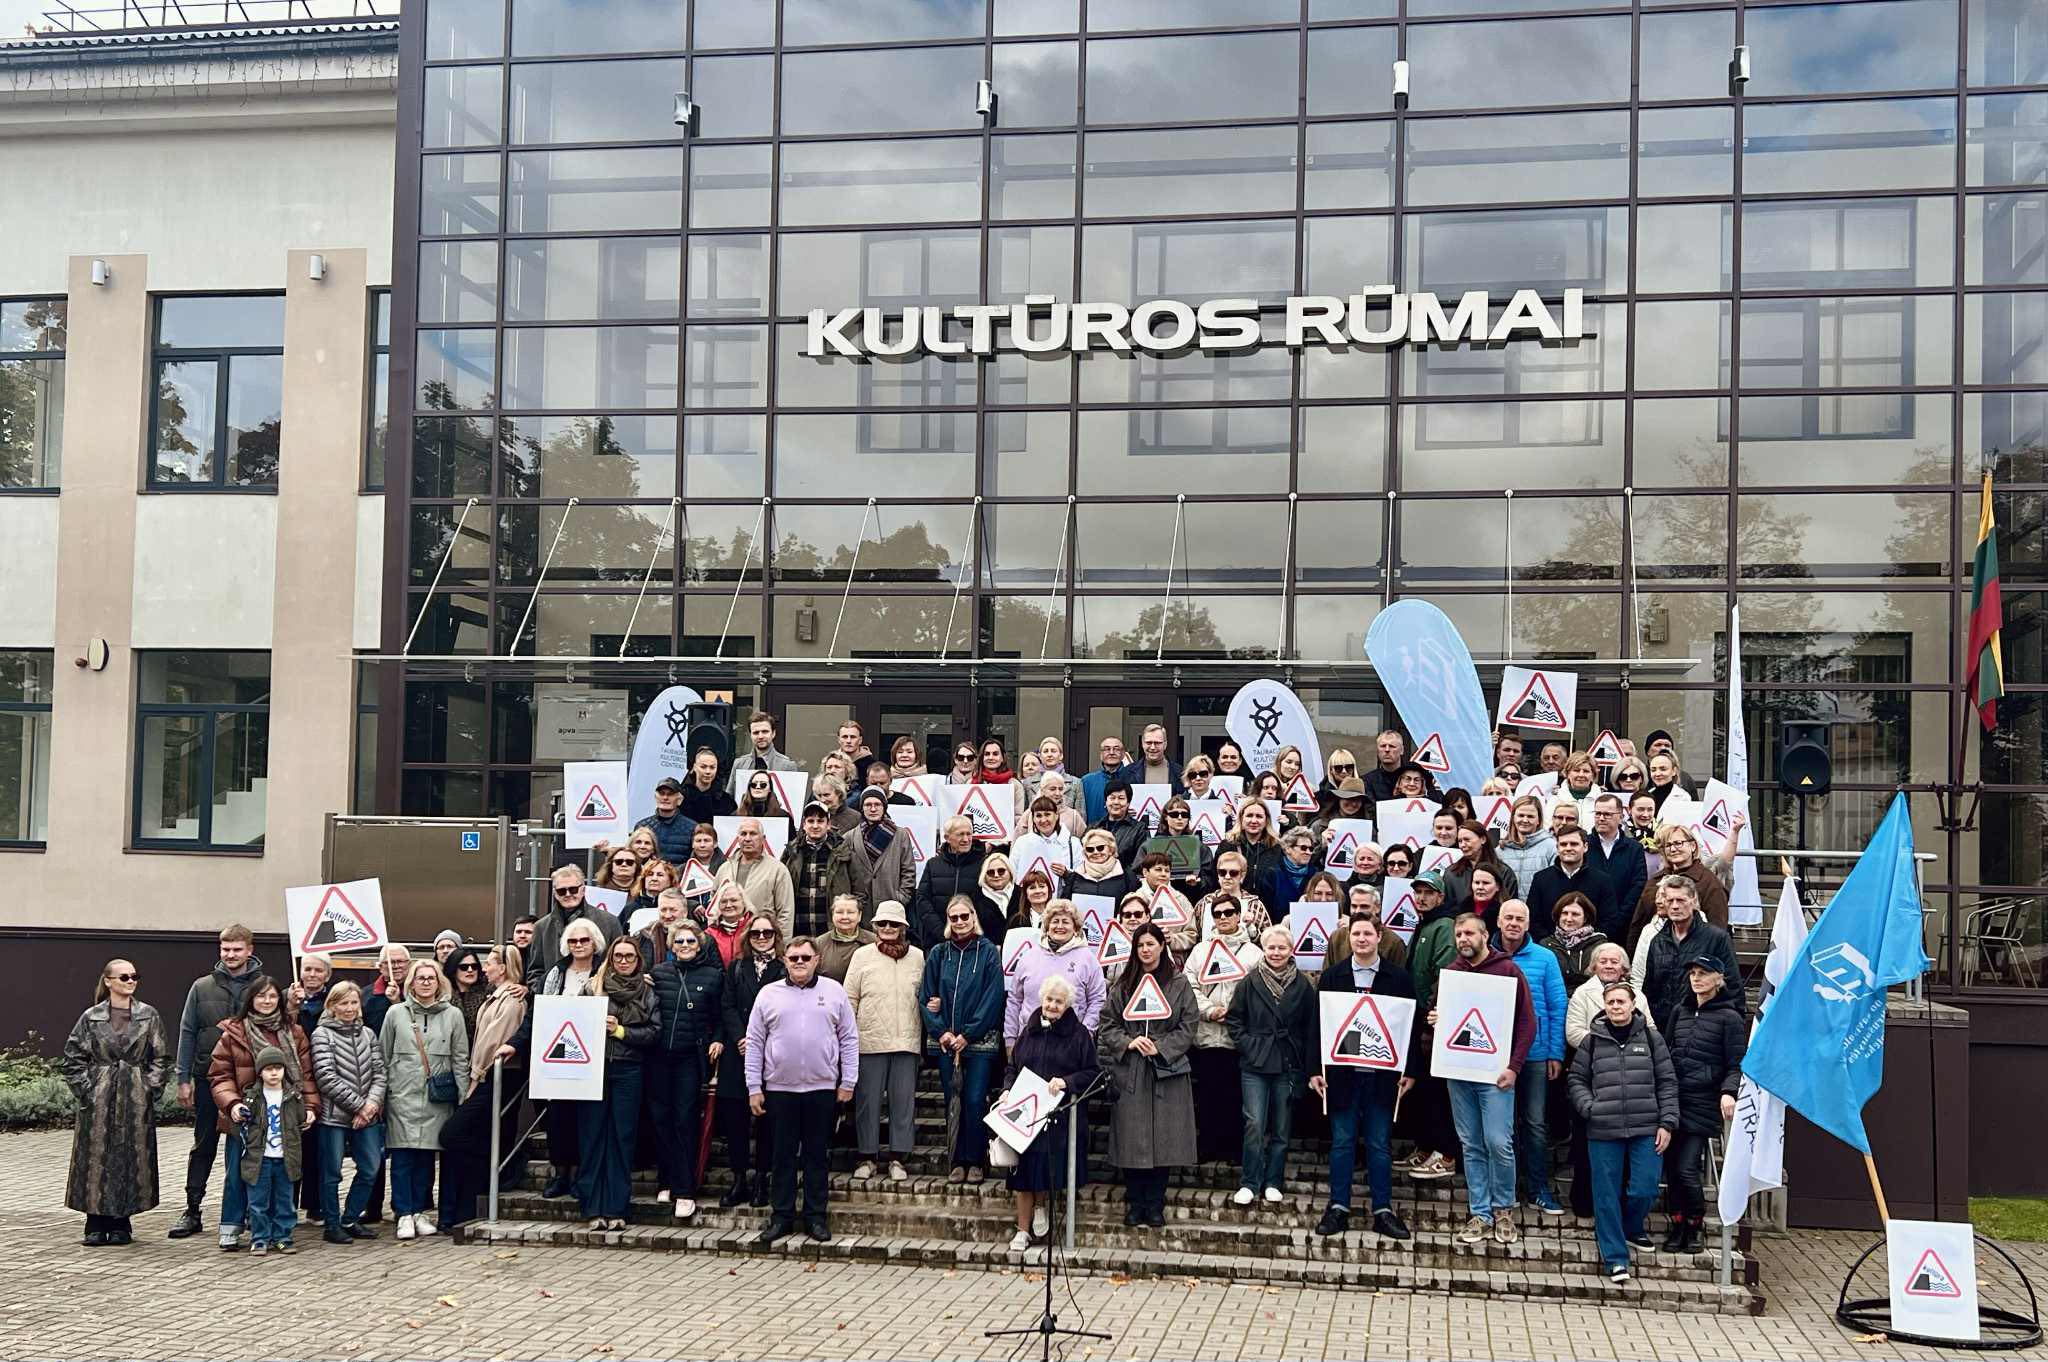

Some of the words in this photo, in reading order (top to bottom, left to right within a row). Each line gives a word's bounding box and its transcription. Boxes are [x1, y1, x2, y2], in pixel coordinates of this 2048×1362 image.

[807, 294, 1260, 356] KULTŪROS
[1286, 285, 1584, 346] RŪMAI
[1530, 690, 1551, 710] kultūra
[967, 805, 990, 822] kultūra
[324, 909, 355, 928] kultūra
[1353, 1017, 1382, 1043] kultūra
